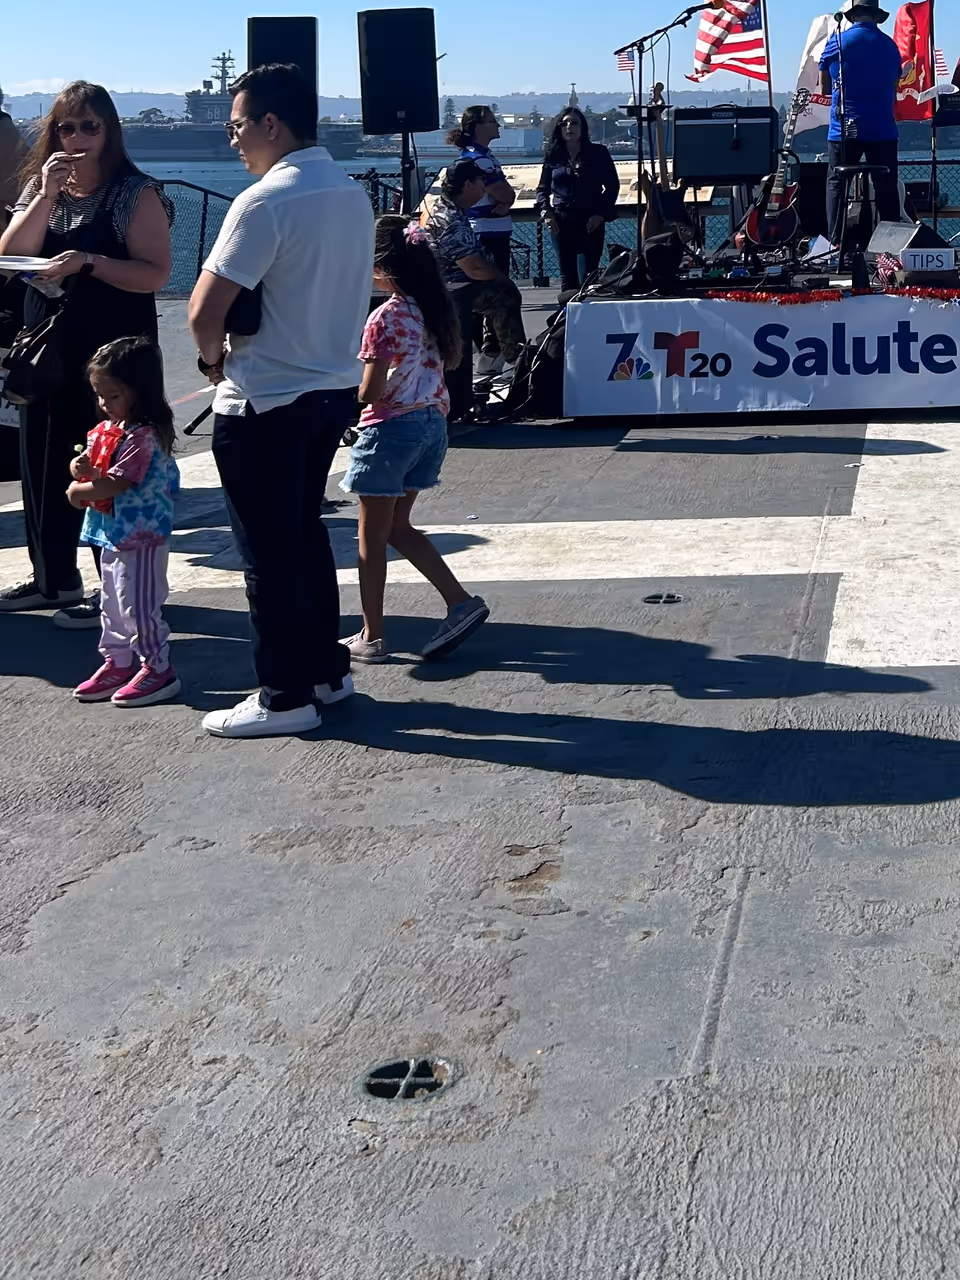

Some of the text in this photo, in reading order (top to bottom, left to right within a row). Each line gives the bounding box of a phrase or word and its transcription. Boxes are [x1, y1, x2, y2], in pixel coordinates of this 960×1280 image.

[207, 105, 221, 120] 68
[909, 254, 944, 268] TIPS
[752, 320, 958, 378] Salute
